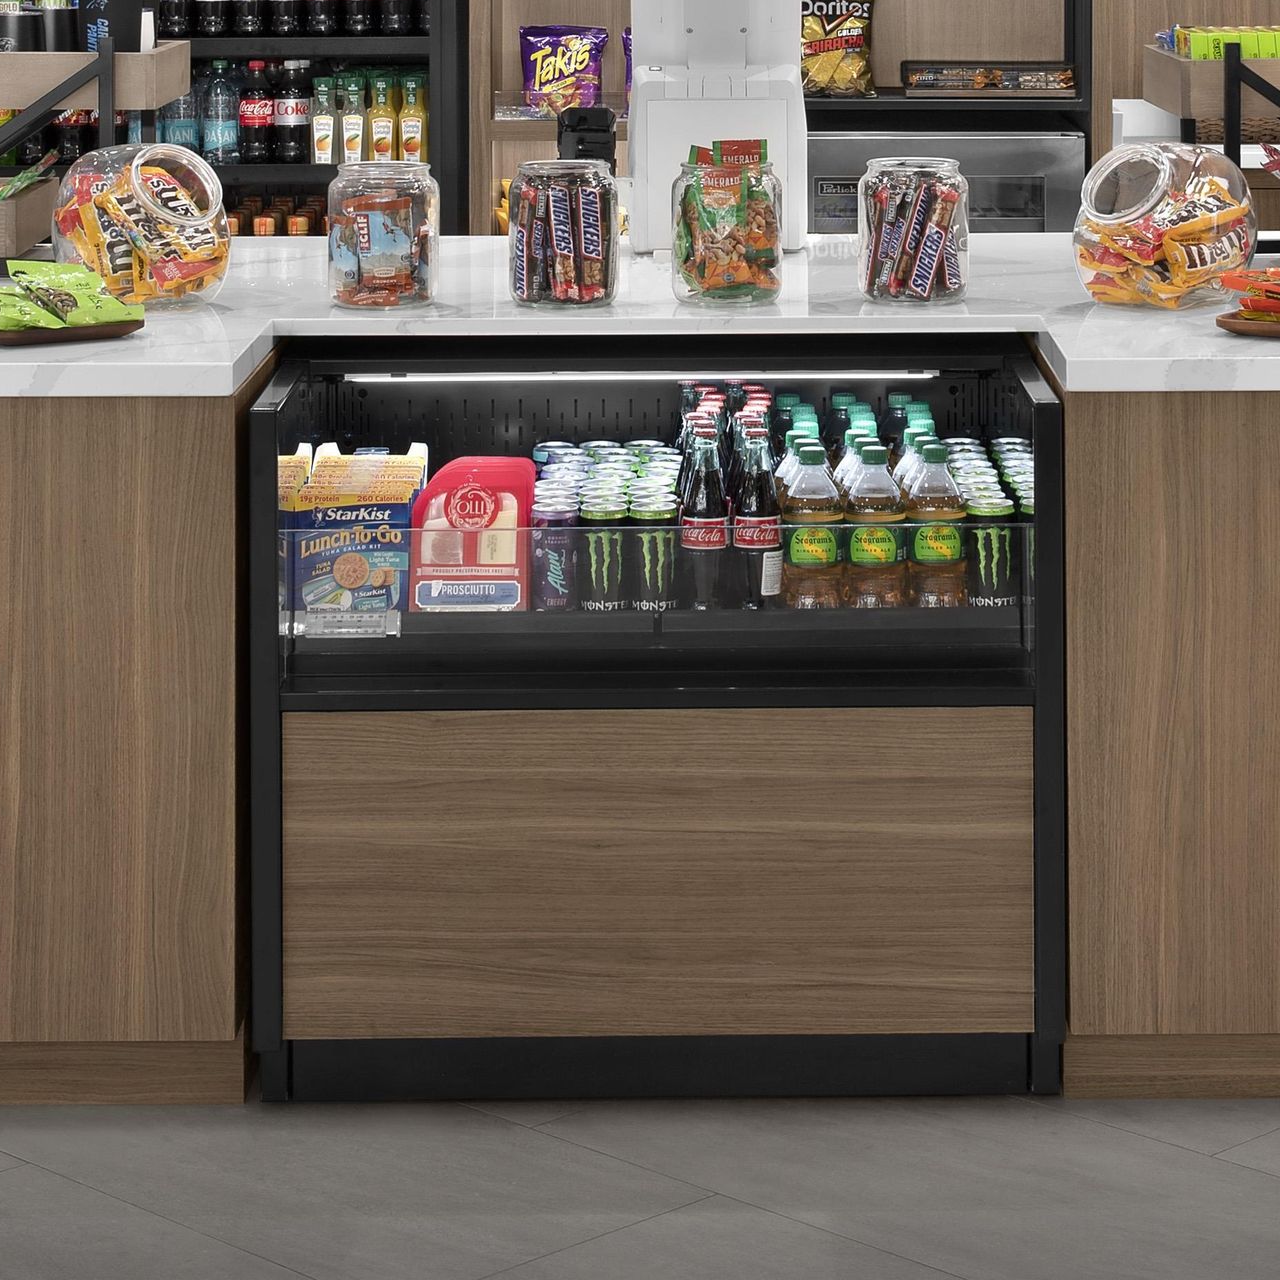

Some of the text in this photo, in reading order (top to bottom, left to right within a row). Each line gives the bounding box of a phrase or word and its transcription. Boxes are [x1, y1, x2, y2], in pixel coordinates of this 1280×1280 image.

[0, 3, 17, 12] GOLD
[531, 39, 590, 88] Takis
[277, 102, 309, 116] Coke
[723, 155, 759, 164] EMERALD
[822, 184, 857, 194] Perlick
[551, 186, 573, 255] SNICKERS
[581, 188, 602, 260] SNICKERS
[912, 229, 944, 296] SNICKERS
[457, 501, 484, 514] OLLI
[326, 508, 391, 520] StarKist
[795, 534, 833, 545] Seagram's
[855, 534, 892, 545] Seagram's
[919, 531, 956, 542] Seagram's
[322, 549, 341, 557] TUNA
[547, 548, 568, 595] Alani
[359, 589, 386, 597] StarKist
[441, 584, 495, 595] PROSCIUTTO
